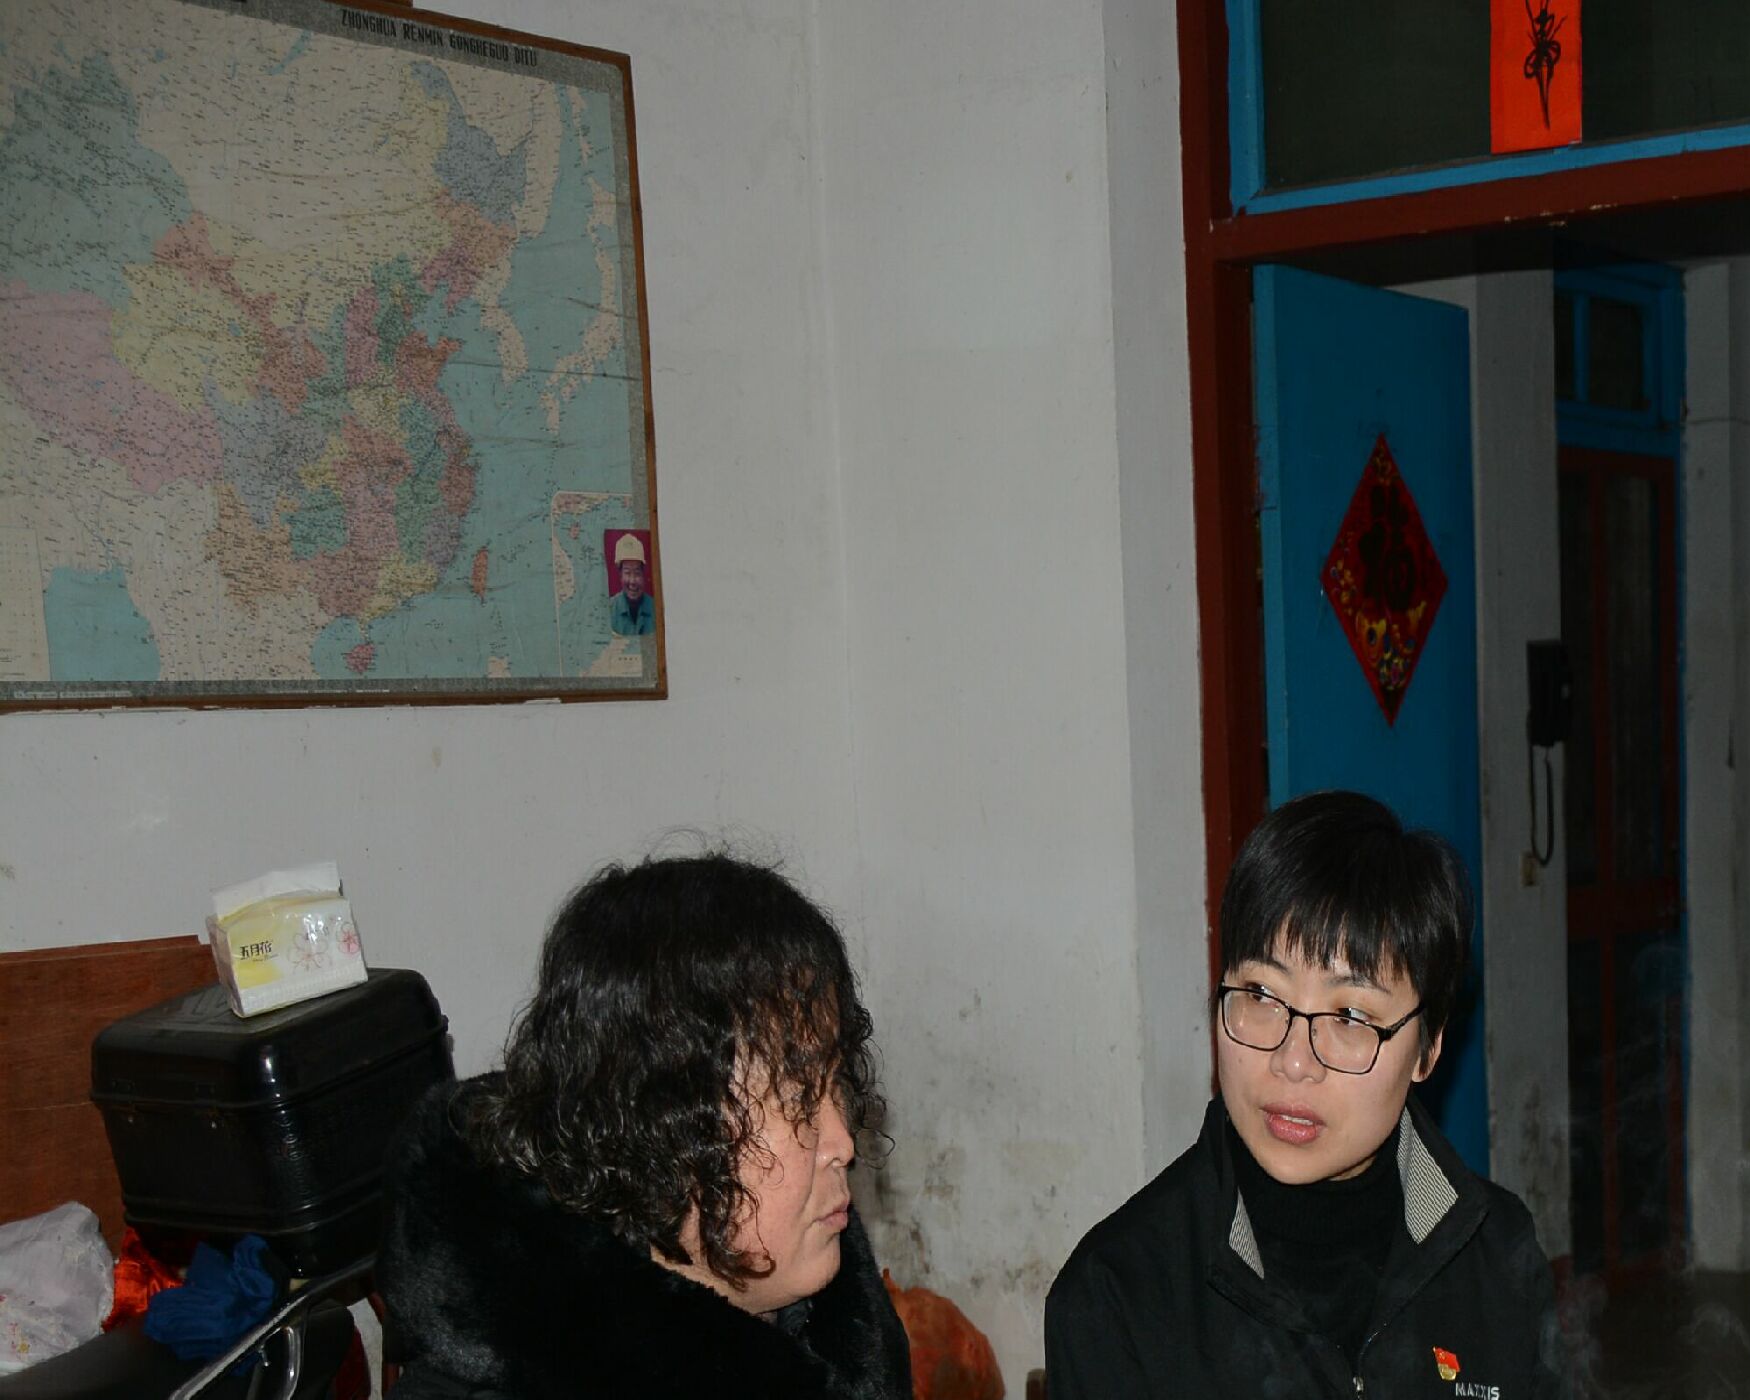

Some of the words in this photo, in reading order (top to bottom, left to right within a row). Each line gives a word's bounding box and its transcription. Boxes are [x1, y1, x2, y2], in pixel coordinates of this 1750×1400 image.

[341, 9, 397, 37] ZHONGHUA
[402, 24, 444, 46] RENMIN
[449, 34, 509, 61] GONGHEGUO
[514, 46, 538, 67] DITU
